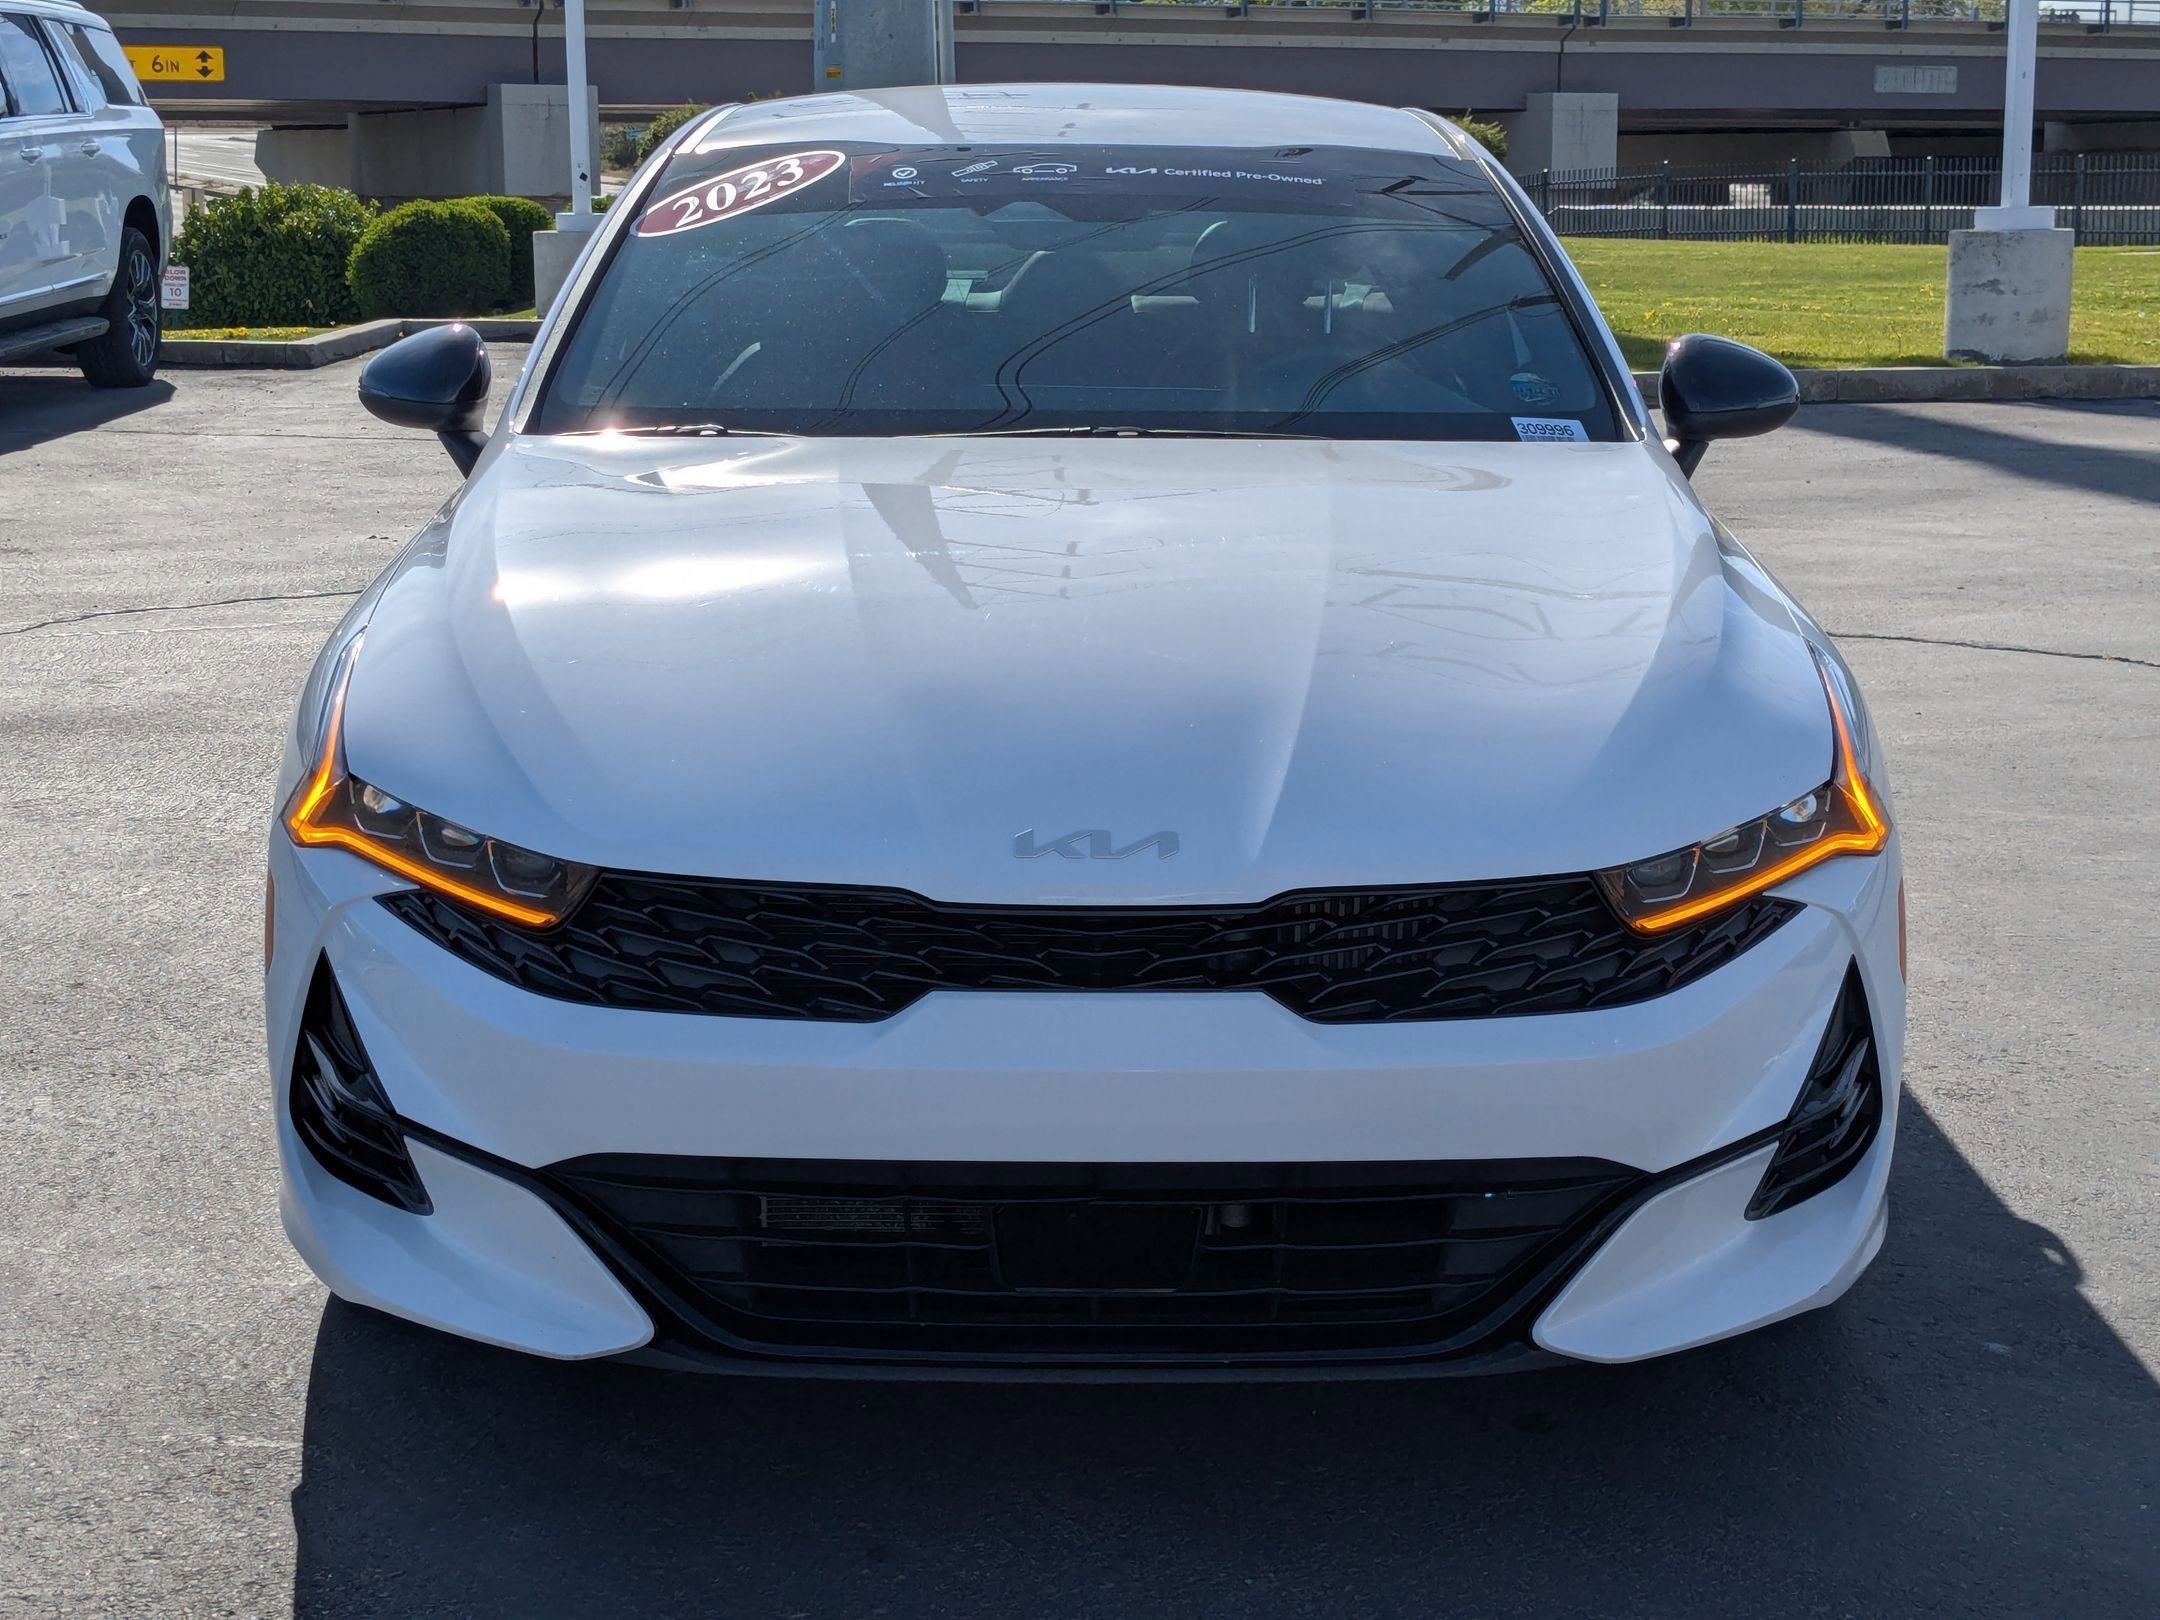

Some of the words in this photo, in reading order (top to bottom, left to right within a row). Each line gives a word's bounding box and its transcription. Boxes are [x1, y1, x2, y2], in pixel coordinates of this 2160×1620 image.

[1164, 168, 1231, 178] Certified
[1236, 171, 1322, 185] Pre-Owned
[672, 158, 804, 228] 2023
[169, 287, 182, 297] 10
[1517, 423, 1575, 437] 309996
[1014, 828, 1179, 860] KIA
